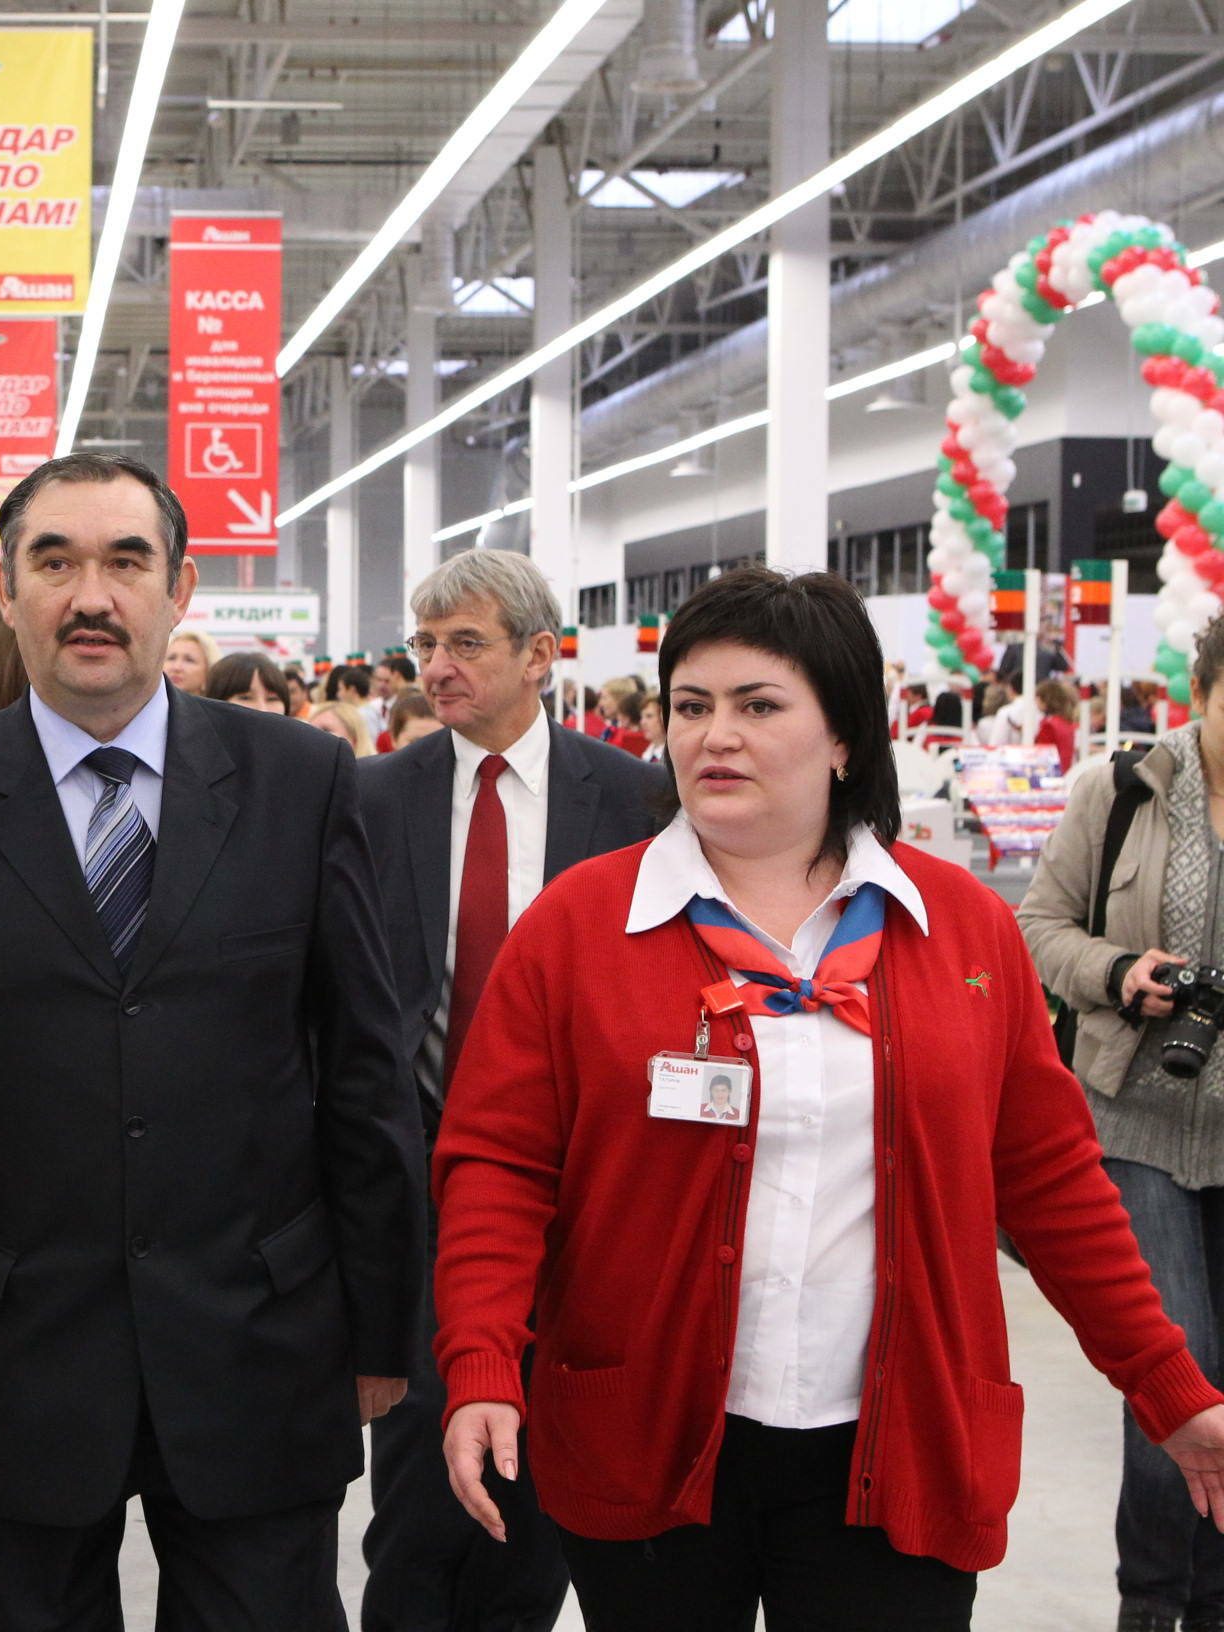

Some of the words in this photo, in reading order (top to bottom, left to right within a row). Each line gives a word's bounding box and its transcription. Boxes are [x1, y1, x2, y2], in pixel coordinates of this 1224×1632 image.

[185, 290, 265, 311] КАССА
[214, 607, 284, 621] КРЕДИТ
[660, 1061, 699, 1075] Ашан
